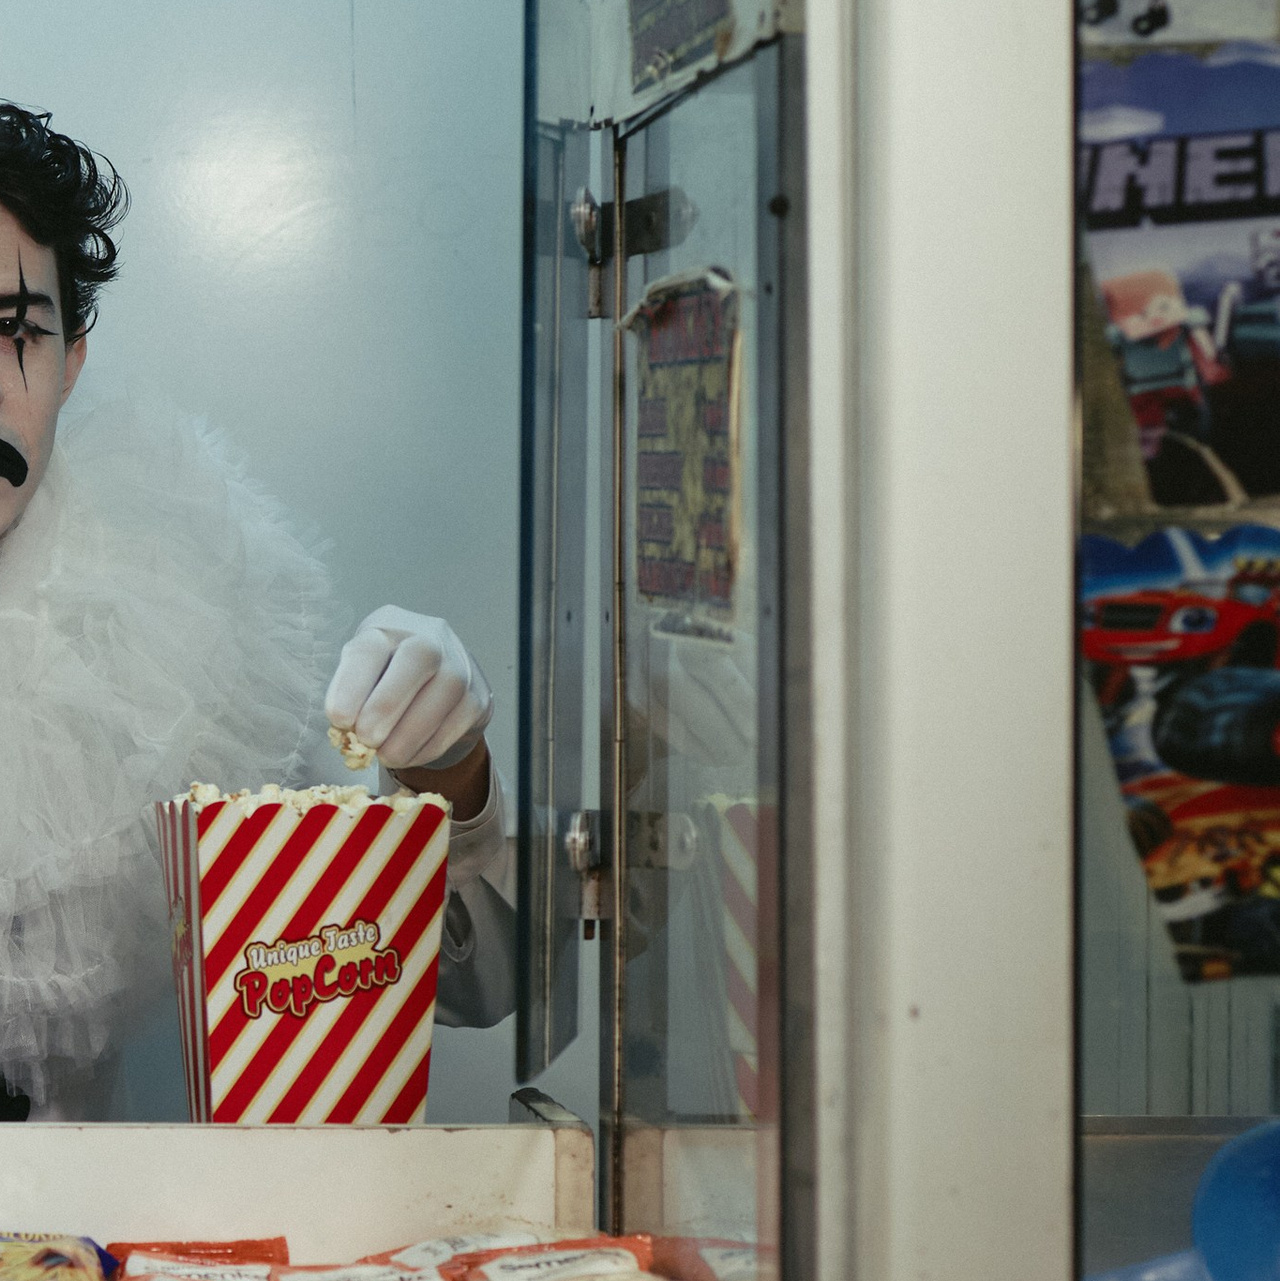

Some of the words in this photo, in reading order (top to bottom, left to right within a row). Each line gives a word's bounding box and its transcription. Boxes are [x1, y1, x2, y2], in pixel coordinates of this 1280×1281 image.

[250, 939, 321, 971] Unique
[324, 922, 377, 952] Taste
[238, 951, 399, 1016] PopCorn
